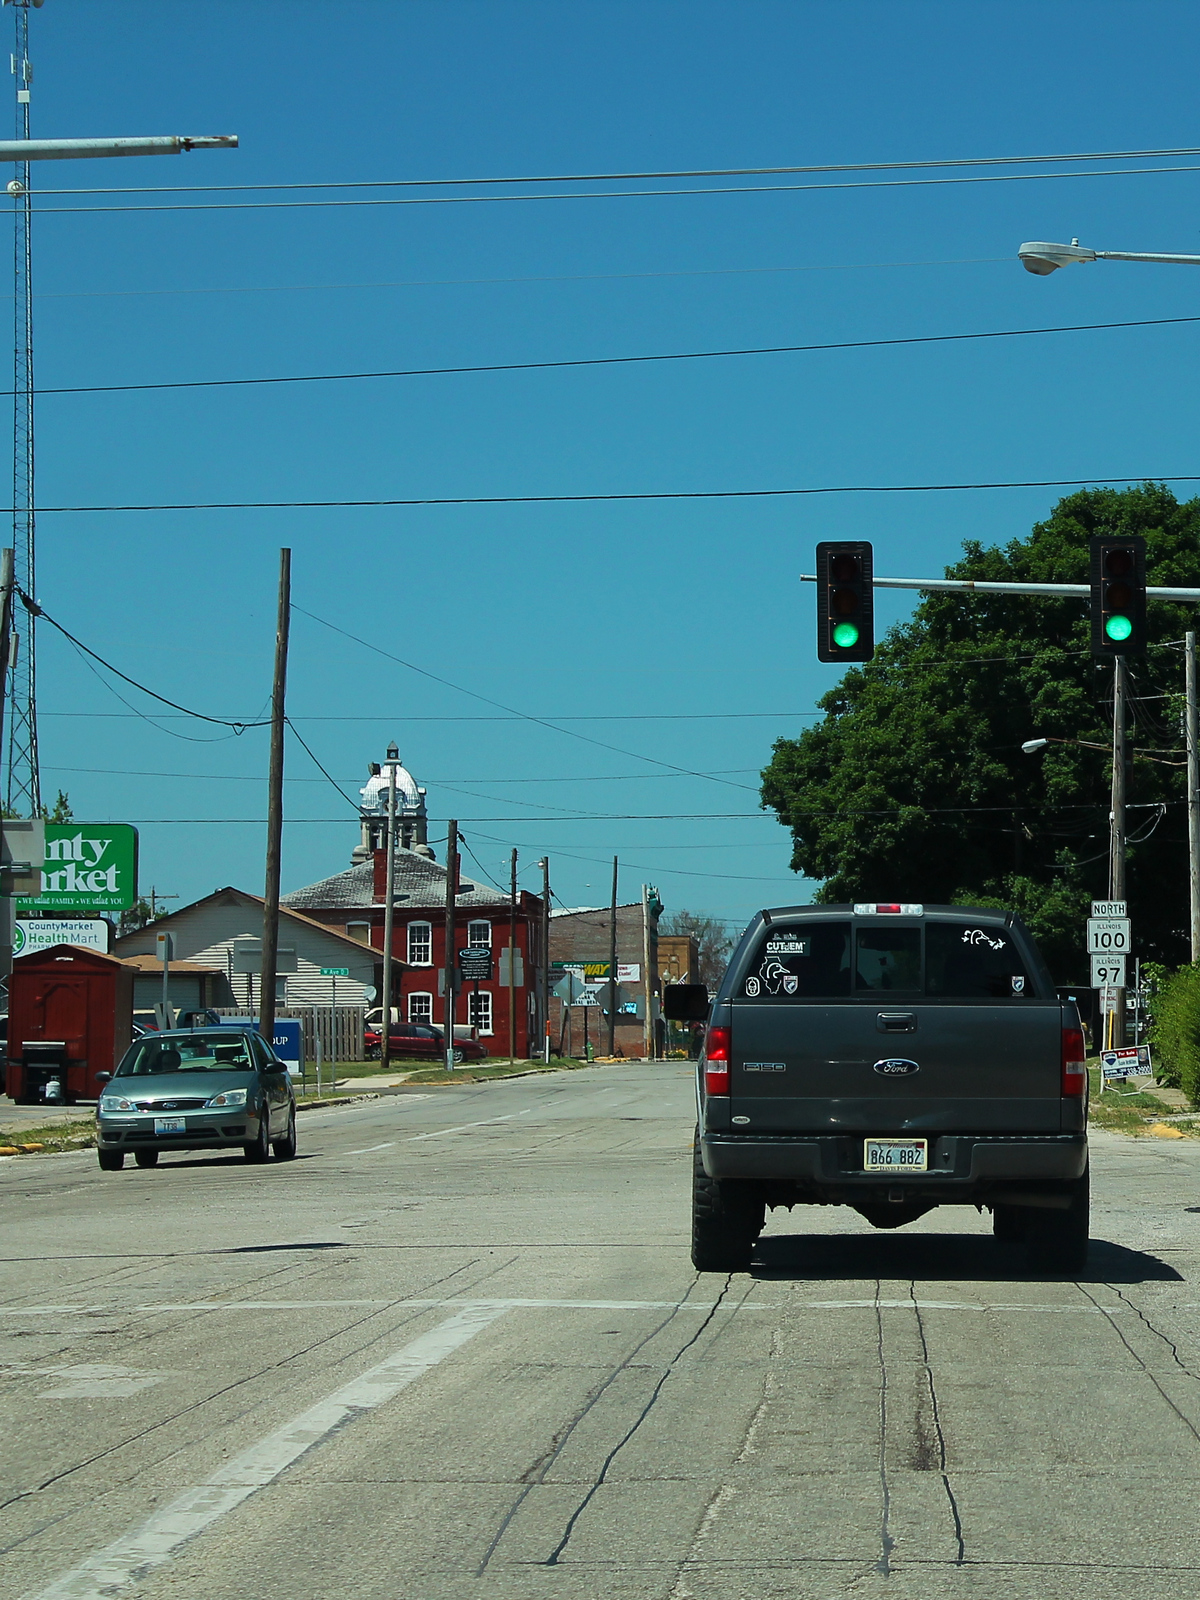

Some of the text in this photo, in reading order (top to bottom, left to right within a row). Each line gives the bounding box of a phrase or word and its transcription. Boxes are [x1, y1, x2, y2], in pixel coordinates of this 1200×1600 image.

[22, 897, 32, 905] WE
[51, 897, 75, 905] FAMILY
[80, 897, 91, 905] WE
[110, 897, 125, 905] YOU
[1094, 904, 1125, 915] NORTH
[1093, 932, 1125, 948] 100
[1097, 967, 1121, 983] 97
[883, 1061, 909, 1073] Ford
[871, 1149, 922, 1165] 866 882
